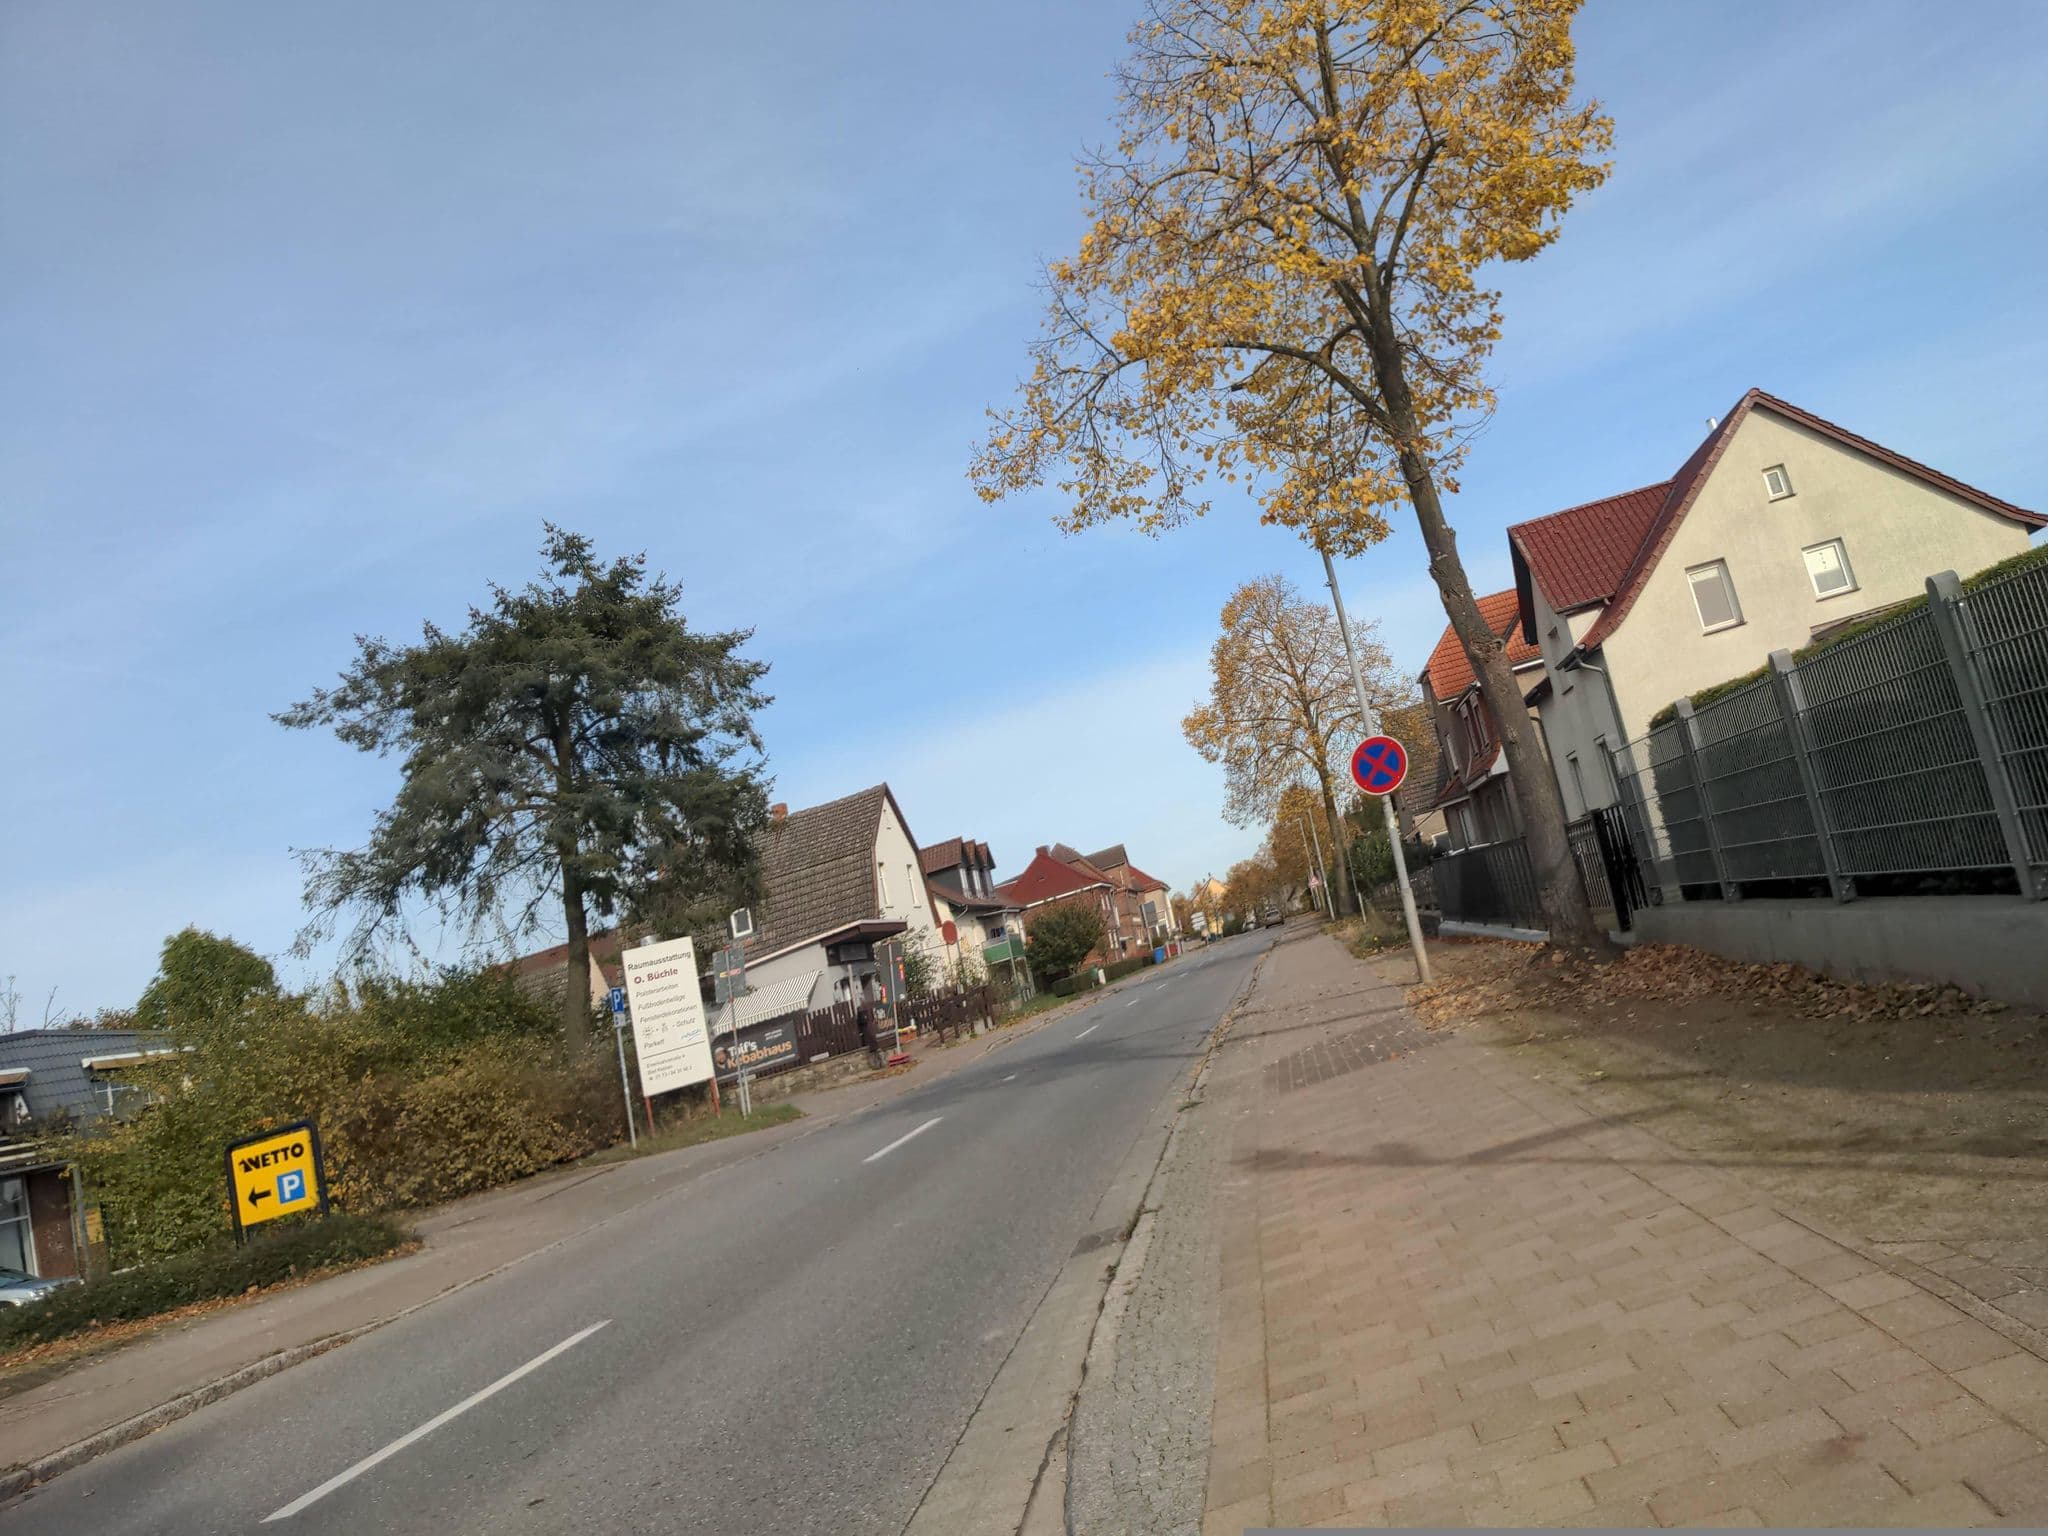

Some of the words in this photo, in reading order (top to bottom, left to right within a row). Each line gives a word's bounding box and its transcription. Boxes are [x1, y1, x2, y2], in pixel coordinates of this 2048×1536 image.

[627, 951, 692, 971] Raumausstattung
[634, 976, 645, 985] O.
[647, 967, 678, 982] Büchle
[613, 991, 621, 1010] P
[727, 1041, 793, 1069] Kebabhaus
[238, 1142, 304, 1173] NETTO
[281, 1174, 301, 1200] P
